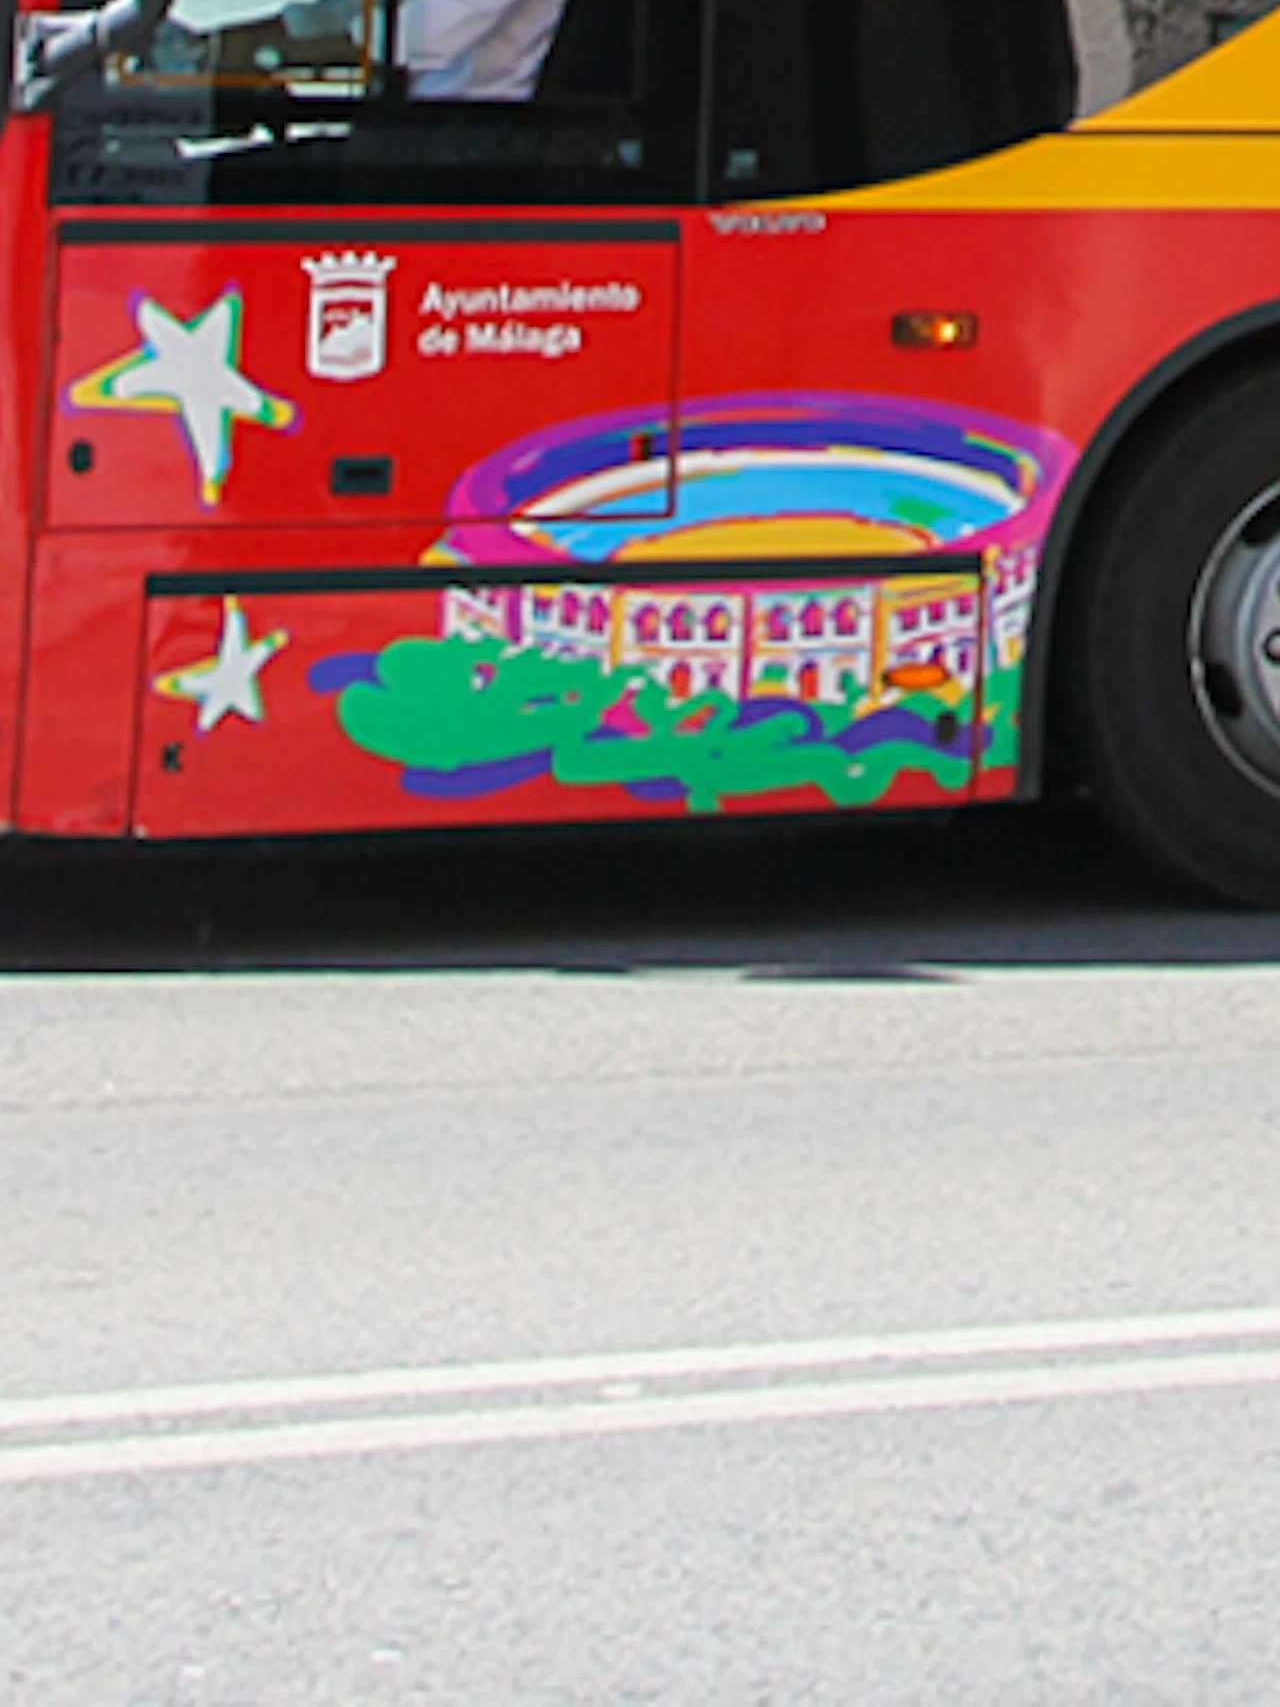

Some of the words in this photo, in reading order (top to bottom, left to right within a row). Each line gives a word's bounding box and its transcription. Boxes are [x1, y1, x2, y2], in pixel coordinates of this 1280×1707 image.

[418, 277, 642, 321] Ayuntamiento
[416, 322, 460, 358] de
[464, 318, 582, 359] Málaga
